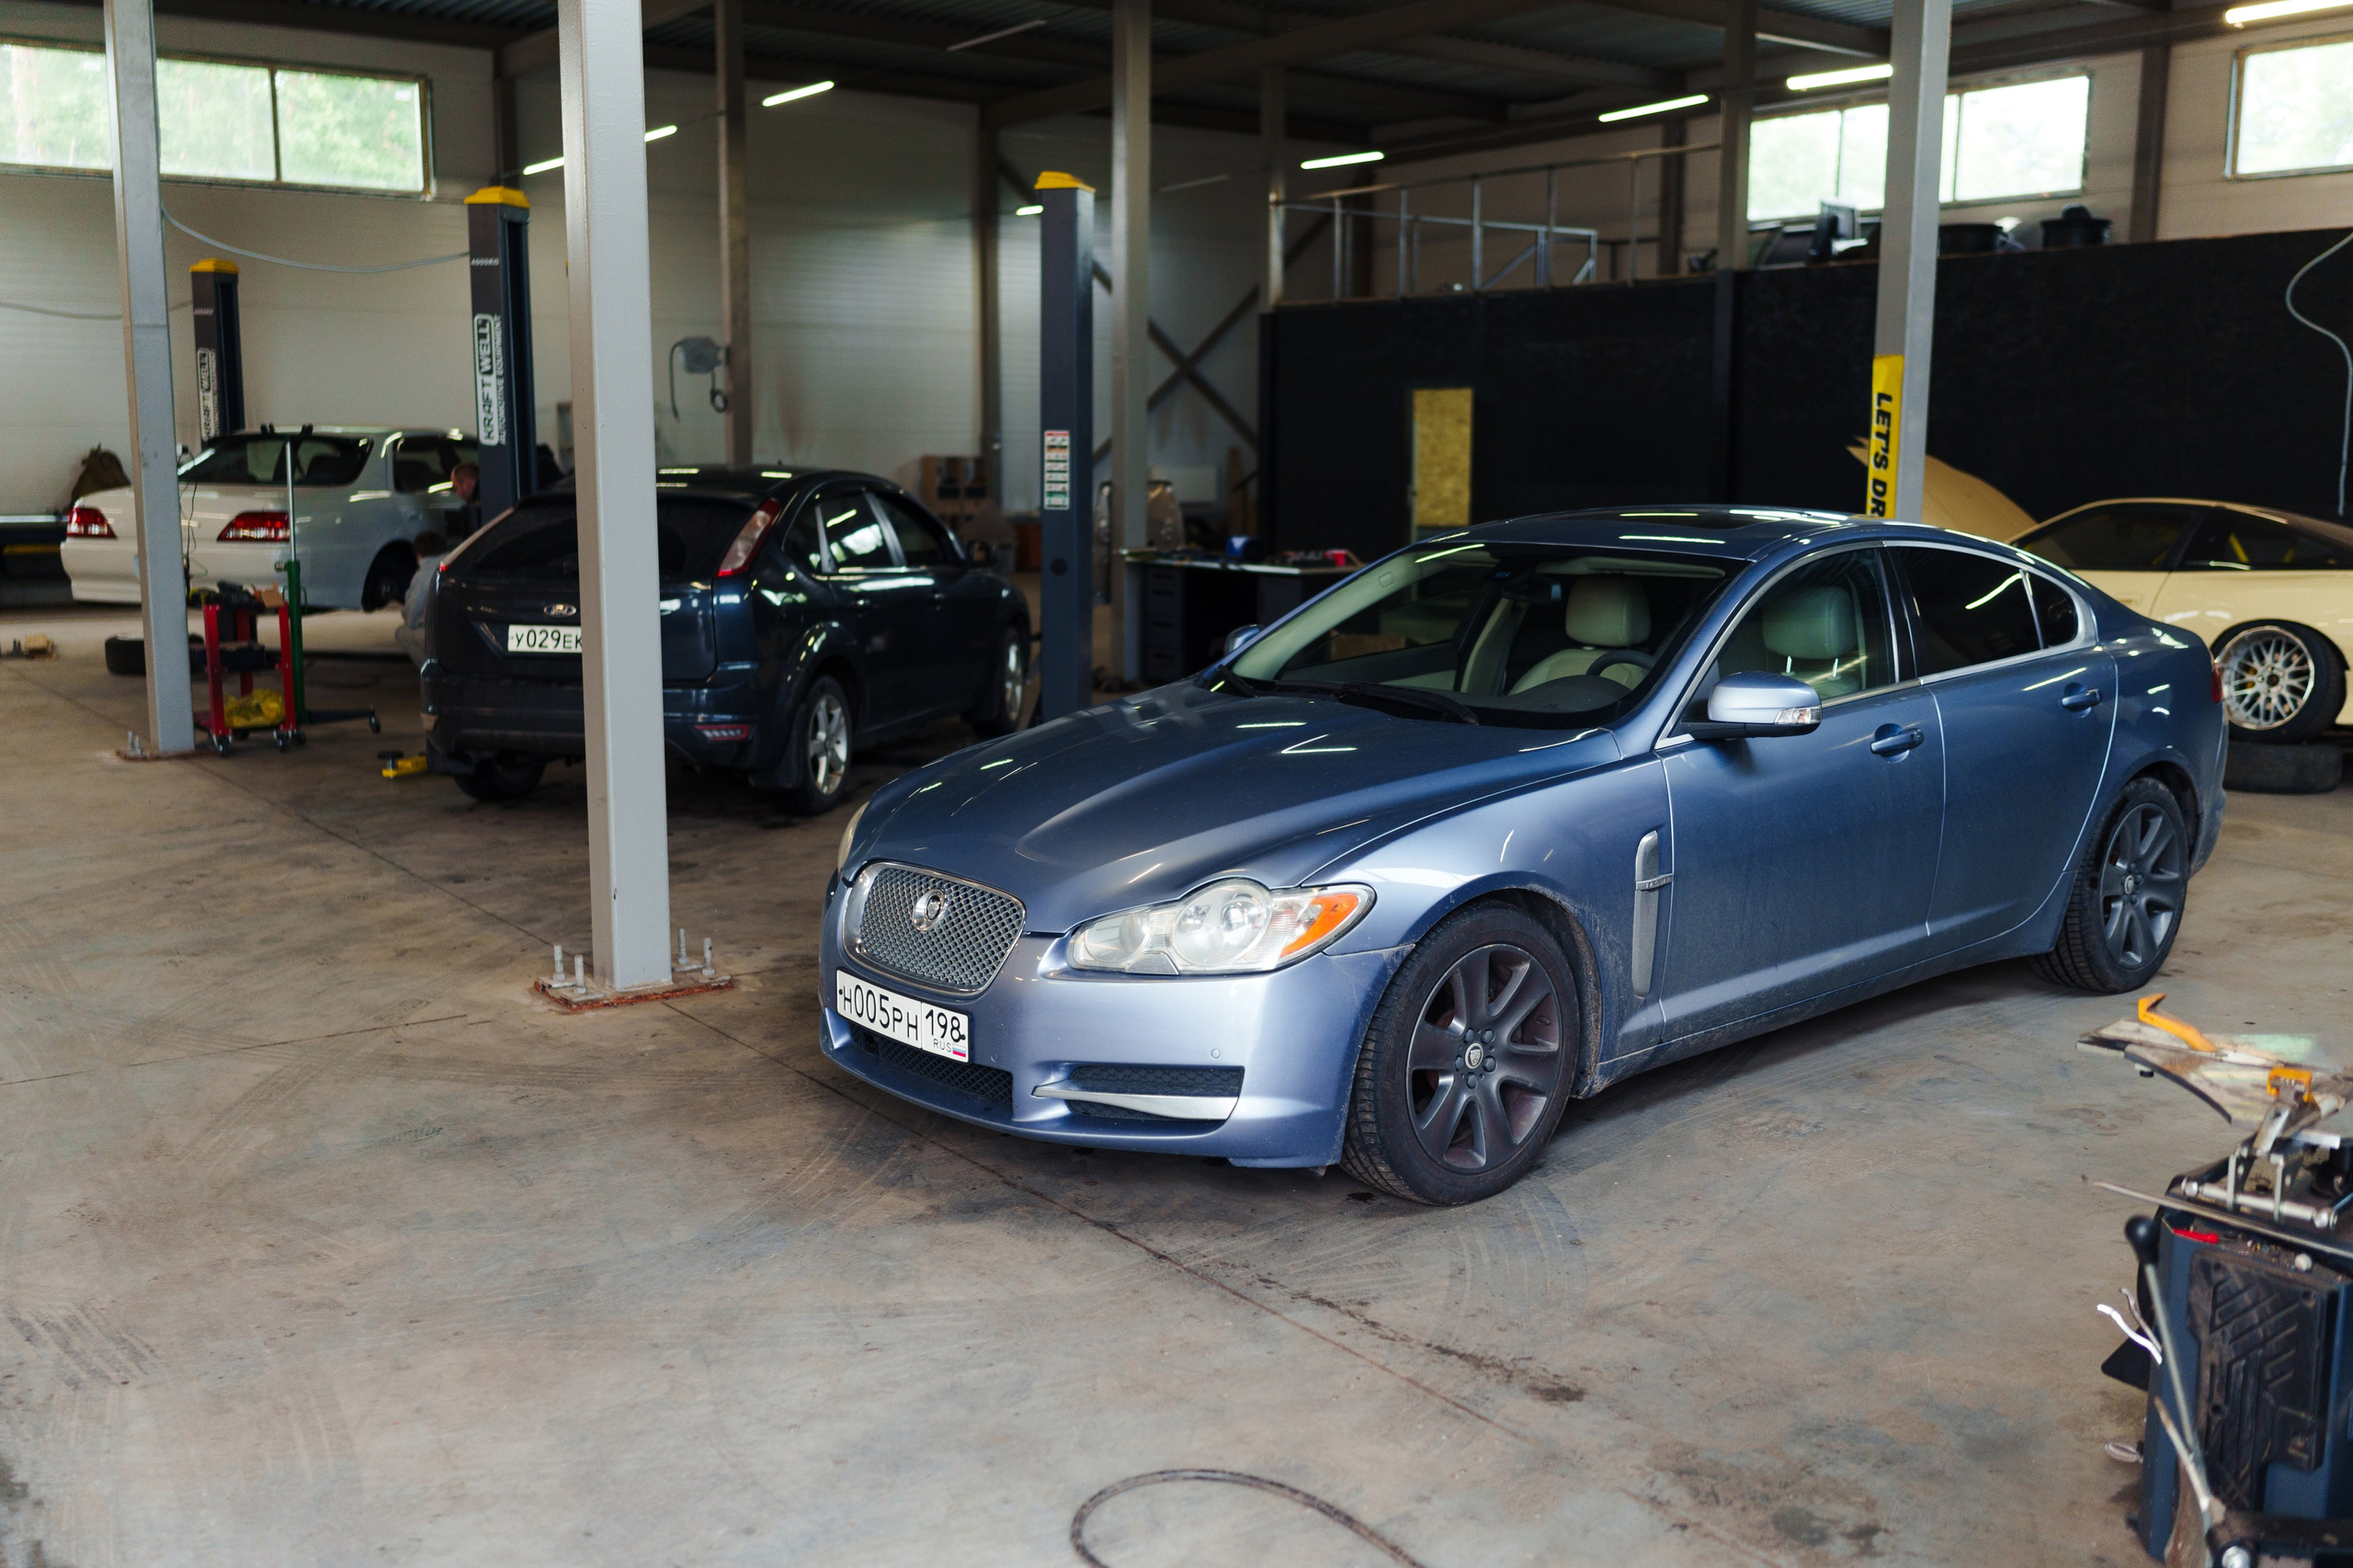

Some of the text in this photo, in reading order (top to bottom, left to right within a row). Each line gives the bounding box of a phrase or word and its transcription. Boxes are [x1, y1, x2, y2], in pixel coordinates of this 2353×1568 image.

[478, 322, 494, 440] KRAFT WELL
[1872, 392, 1893, 471] LET'S
[926, 1008, 962, 1043] 198
[933, 1038, 952, 1053] RUS
